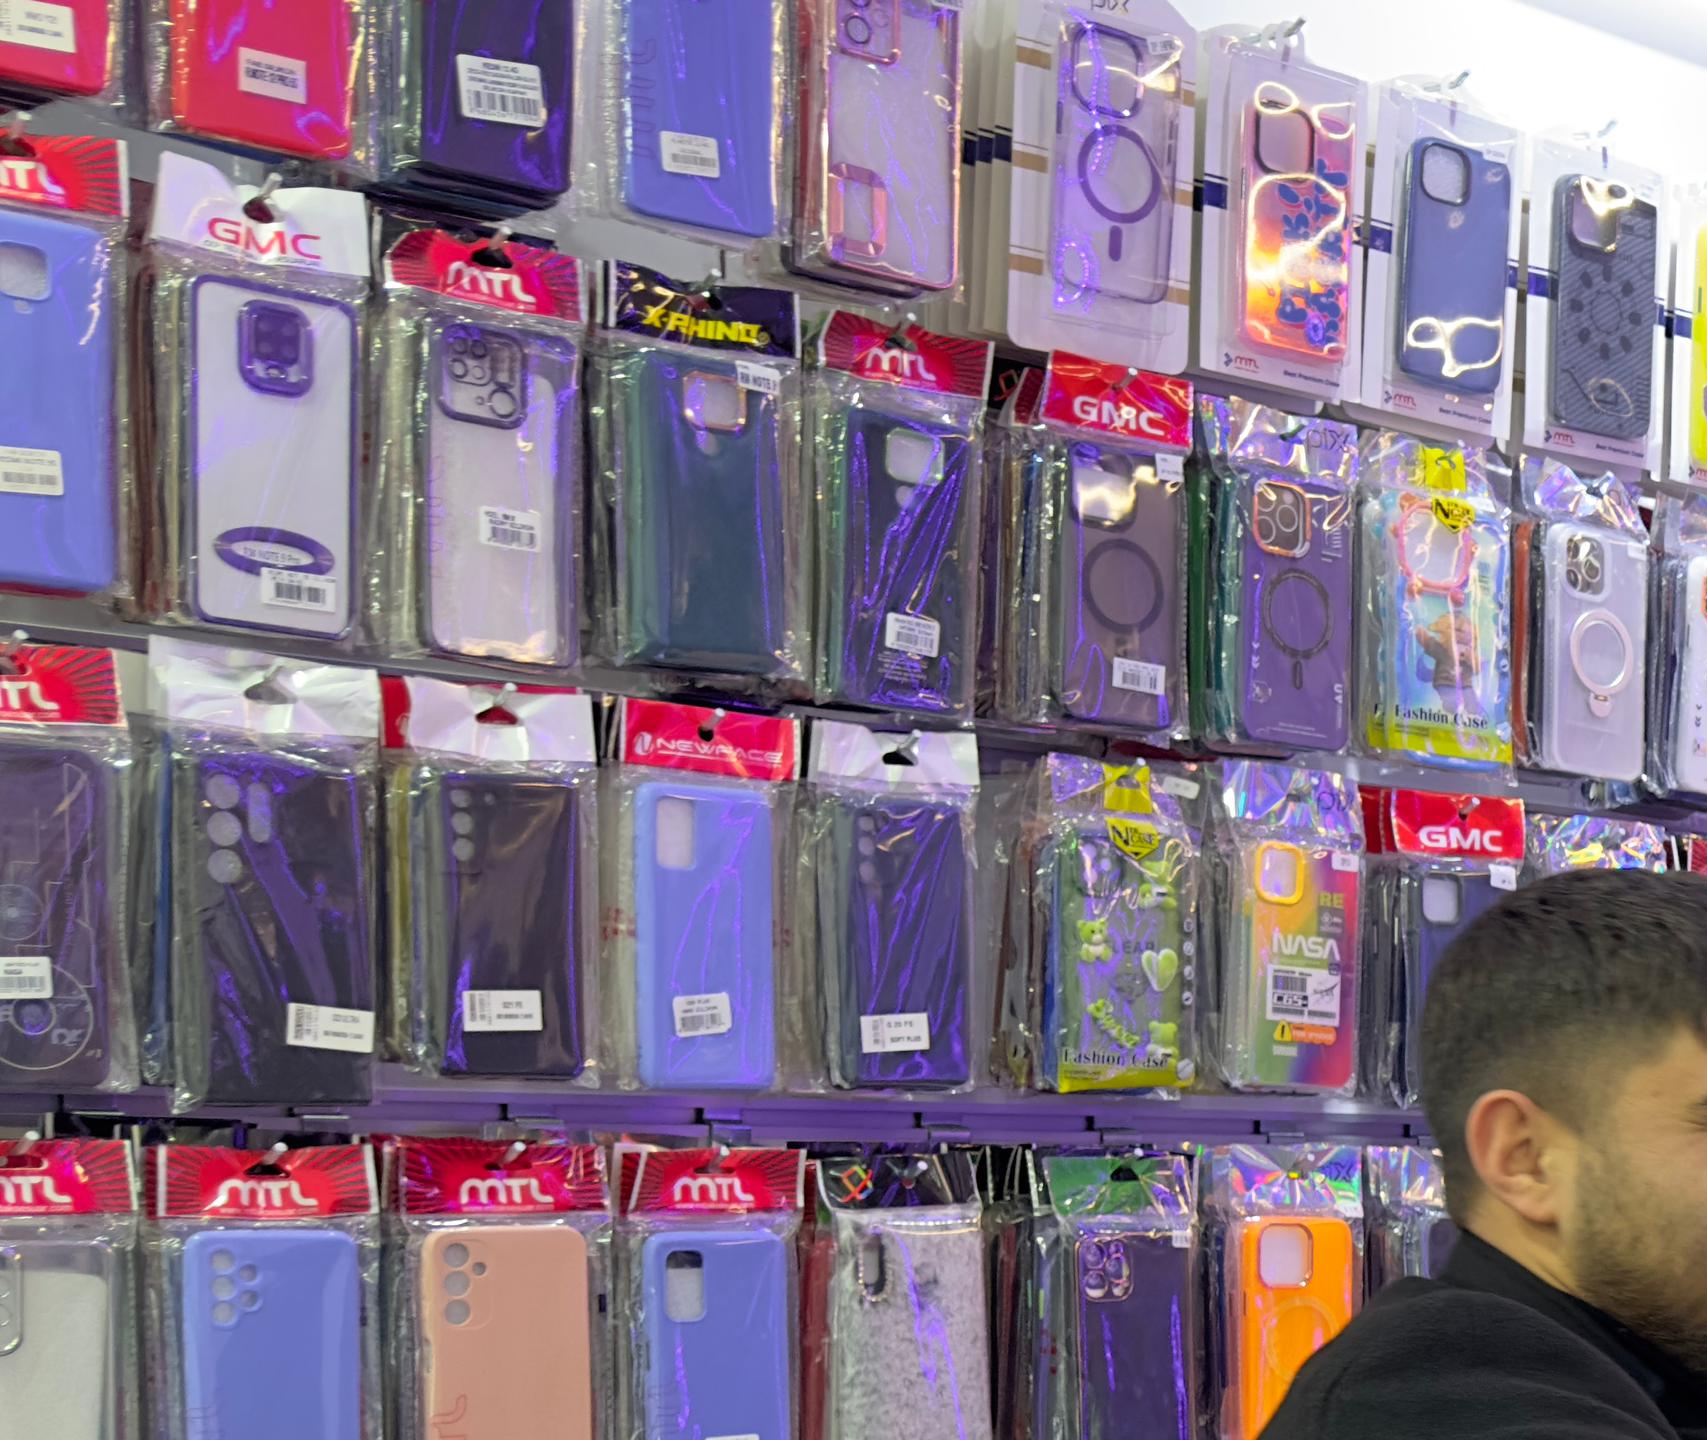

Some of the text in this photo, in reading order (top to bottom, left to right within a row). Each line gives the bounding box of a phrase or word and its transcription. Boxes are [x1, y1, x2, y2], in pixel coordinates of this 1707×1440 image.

[206, 216, 322, 262] GMC
[448, 260, 536, 304] MTL
[643, 305, 762, 345] X-RHINO
[866, 346, 936, 382] MTL
[1073, 395, 1165, 436] GMC
[0, 680, 60, 711] TL
[1394, 703, 1489, 730] Fashion Case
[655, 737, 784, 764] NEWFACE
[1419, 825, 1503, 852] GMC
[1271, 932, 1341, 961] NASA
[1063, 1048, 1125, 1067] Fashion
[218, 1178, 319, 1208] MTL
[460, 1177, 555, 1205] MTL
[674, 1175, 755, 1203] MTL
